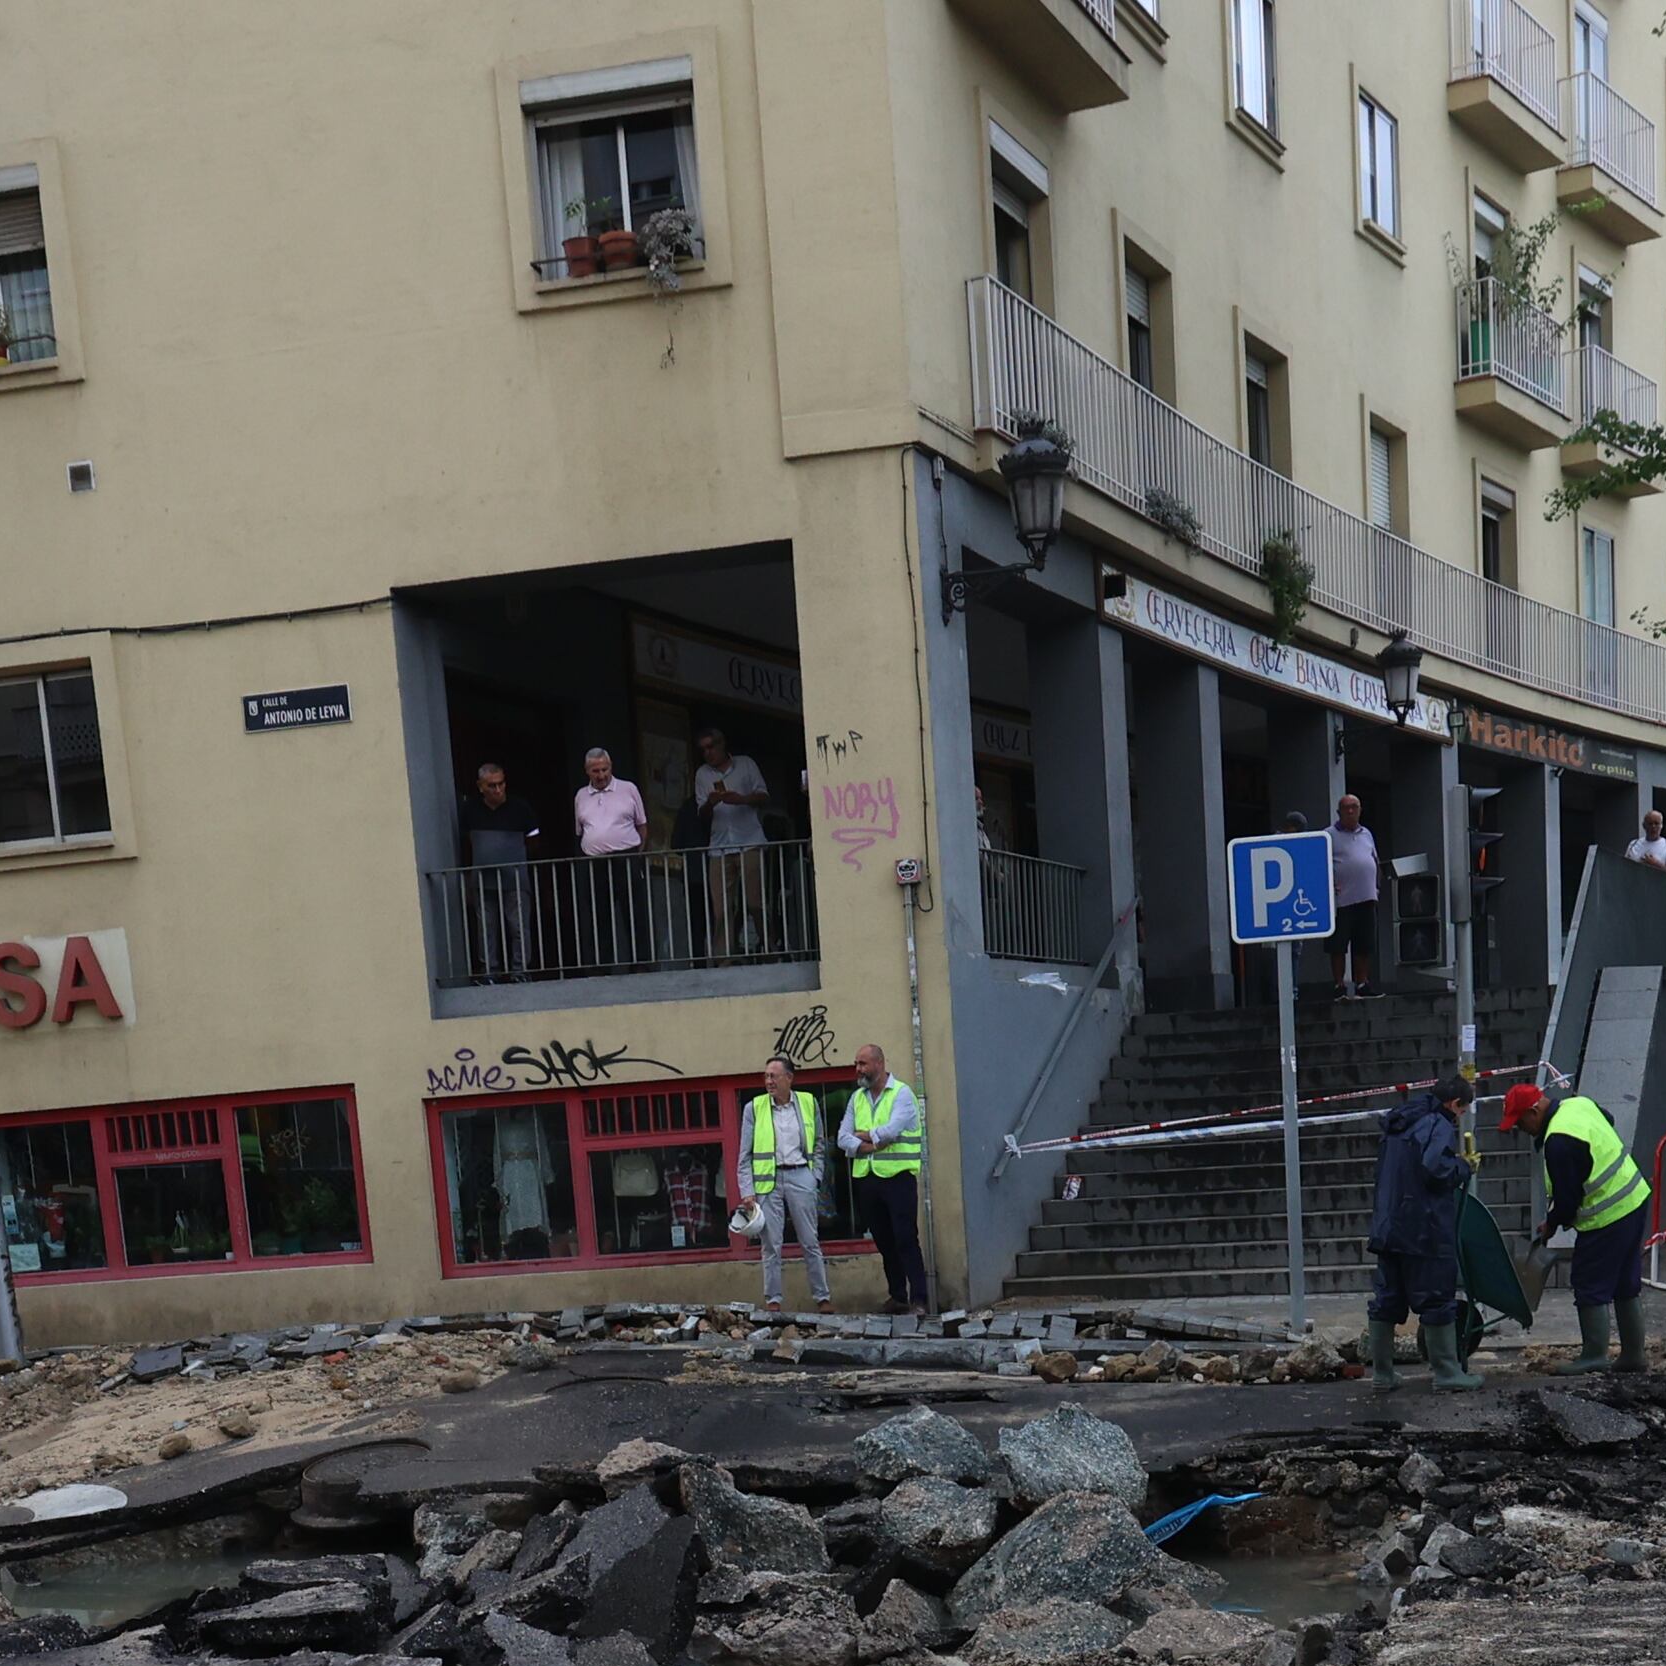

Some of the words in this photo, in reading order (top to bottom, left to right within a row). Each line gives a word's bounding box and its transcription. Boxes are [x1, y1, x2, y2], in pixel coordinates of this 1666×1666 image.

[1146, 588, 1237, 659] CERVECERIA
[262, 697, 279, 707] CALLE
[280, 696, 288, 705] DE
[264, 709, 304, 725] ANTONIO
[305, 707, 318, 721] DE
[319, 704, 345, 719] LEYVA
[1591, 761, 1635, 778] reptile
[1250, 846, 1295, 928] P
[1282, 918, 1293, 932] 2
